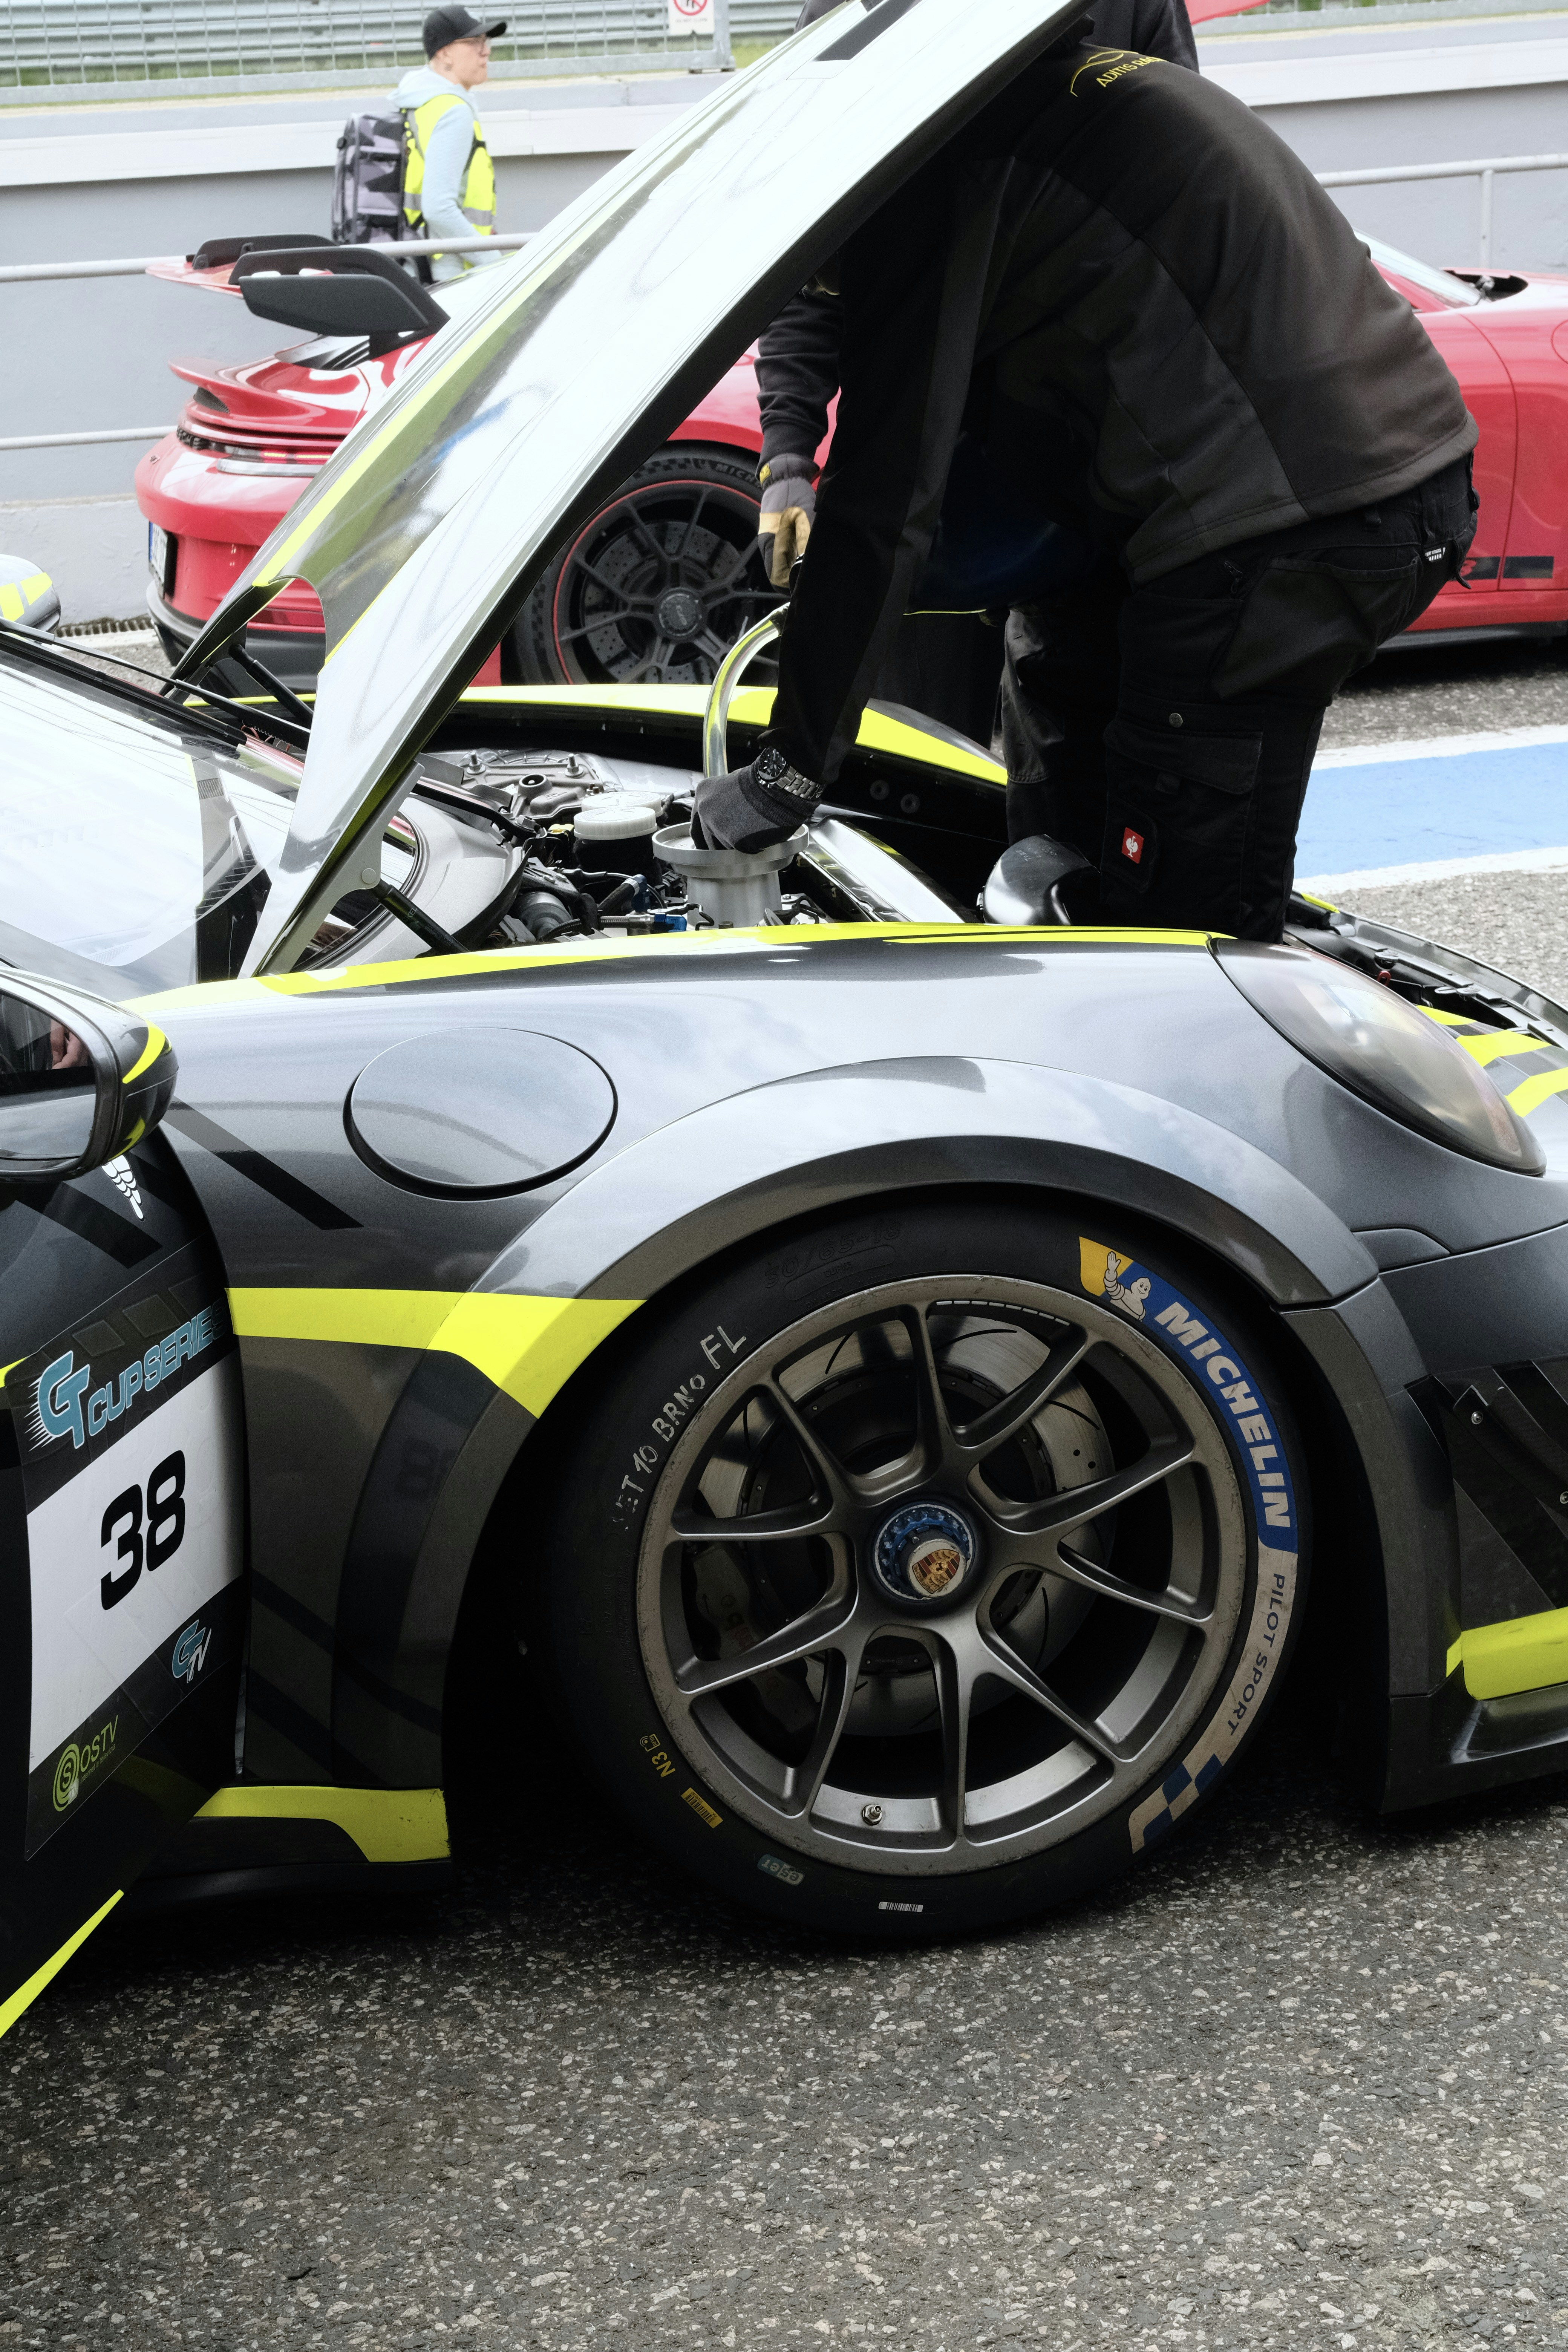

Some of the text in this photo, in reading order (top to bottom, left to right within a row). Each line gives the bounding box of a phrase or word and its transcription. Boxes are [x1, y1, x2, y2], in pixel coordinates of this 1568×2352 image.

[1096, 63, 1138, 87] ADITIS
[37, 1350, 90, 1449] GT
[633, 1445, 659, 1474] 10
[700, 1325, 747, 1370] FL
[1154, 1301, 1291, 1528] MICHELIN
[100, 1450, 186, 1610] 38
[1227, 1573, 1285, 1736] PILOT SPORT
[651, 1752, 676, 1778] N3
[761, 1859, 799, 1881] eset
